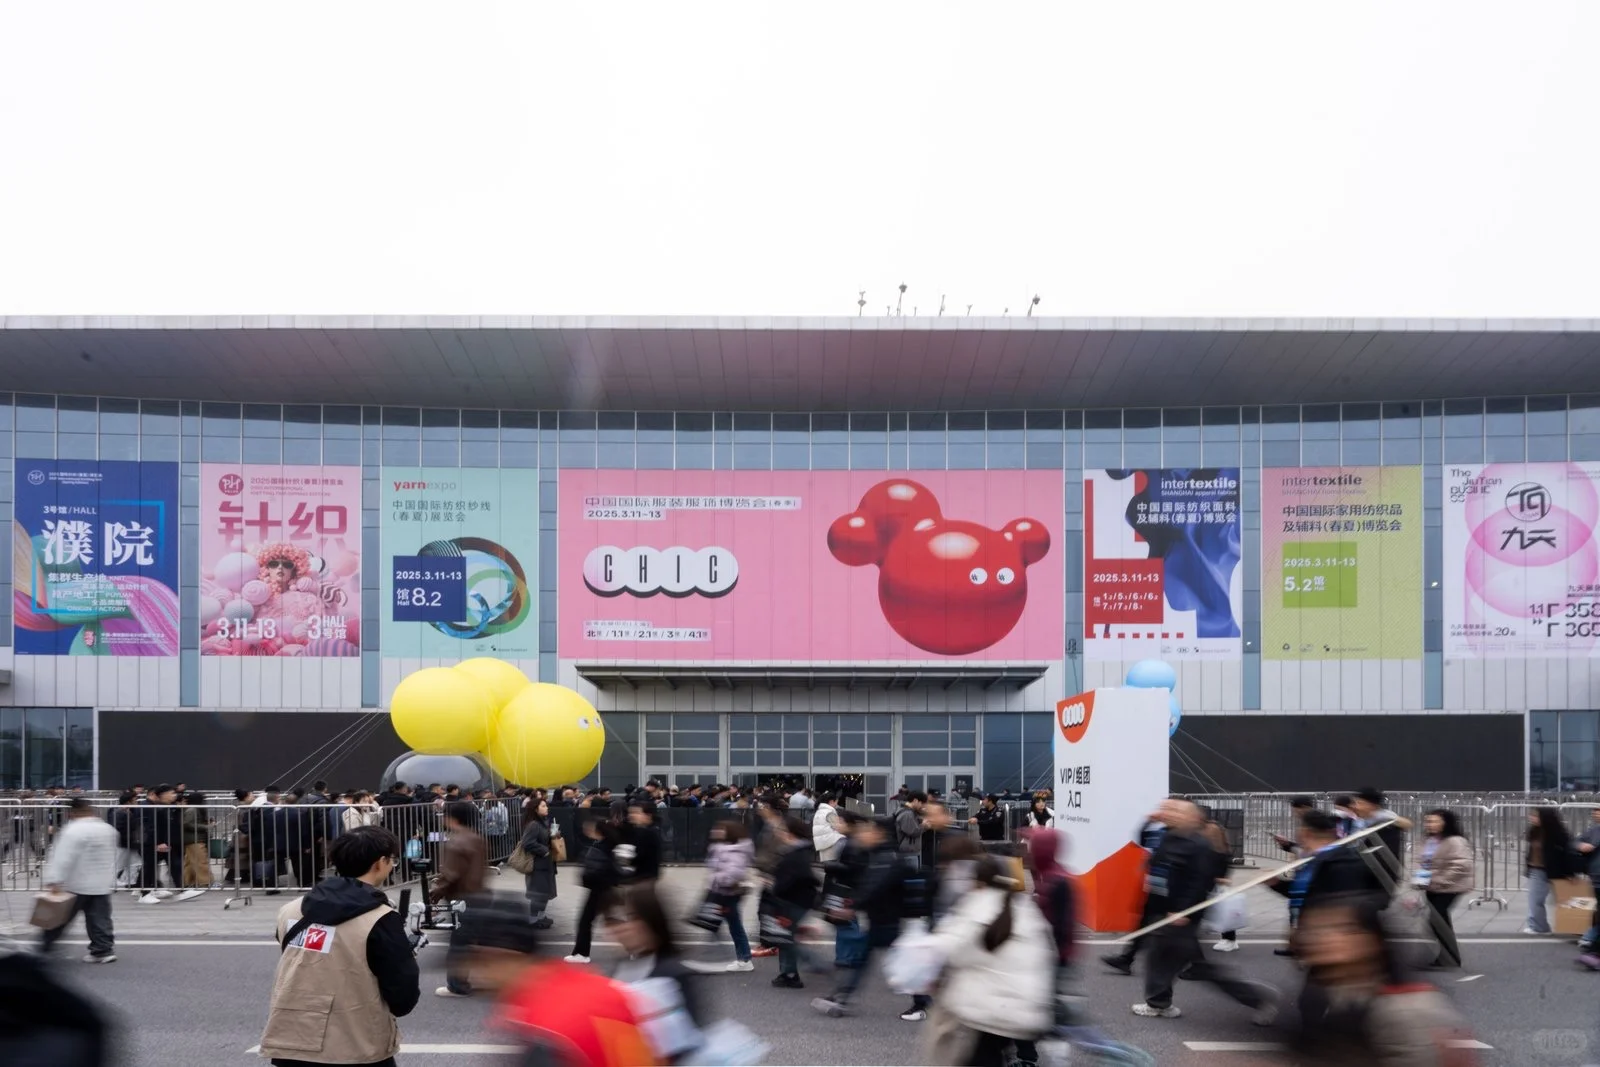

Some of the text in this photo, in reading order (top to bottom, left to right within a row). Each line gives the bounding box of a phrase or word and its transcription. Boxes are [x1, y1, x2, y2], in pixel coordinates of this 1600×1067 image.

[393, 481, 457, 492] yarnexpo
[1161, 477, 1236, 489] intertextile
[1282, 474, 1362, 486] intertextile
[393, 500, 491, 511] 中国国际纺织纱线
[1137, 502, 1236, 513] 中国国际纺织面料
[1282, 504, 1402, 517] 中国国际家用纺织品
[218, 501, 347, 549] 针织
[1283, 519, 1402, 532] 及辅料(春夏)博览会
[41, 519, 154, 566] 濮院
[604, 554, 717, 583] CHIC
[1284, 558, 1356, 567] 2025.3.11-13
[396, 571, 462, 580] 2025.3.11-13
[1093, 573, 1159, 582] 2025.3.11-13
[1284, 576, 1312, 591] 5.2
[412, 587, 442, 607] 8.2
[217, 617, 276, 638] 3.11-13
[307, 615, 321, 639] 3
[323, 616, 347, 627] HALL
[1060, 766, 1090, 784] VIP/组团
[1067, 790, 1081, 808] 入口
